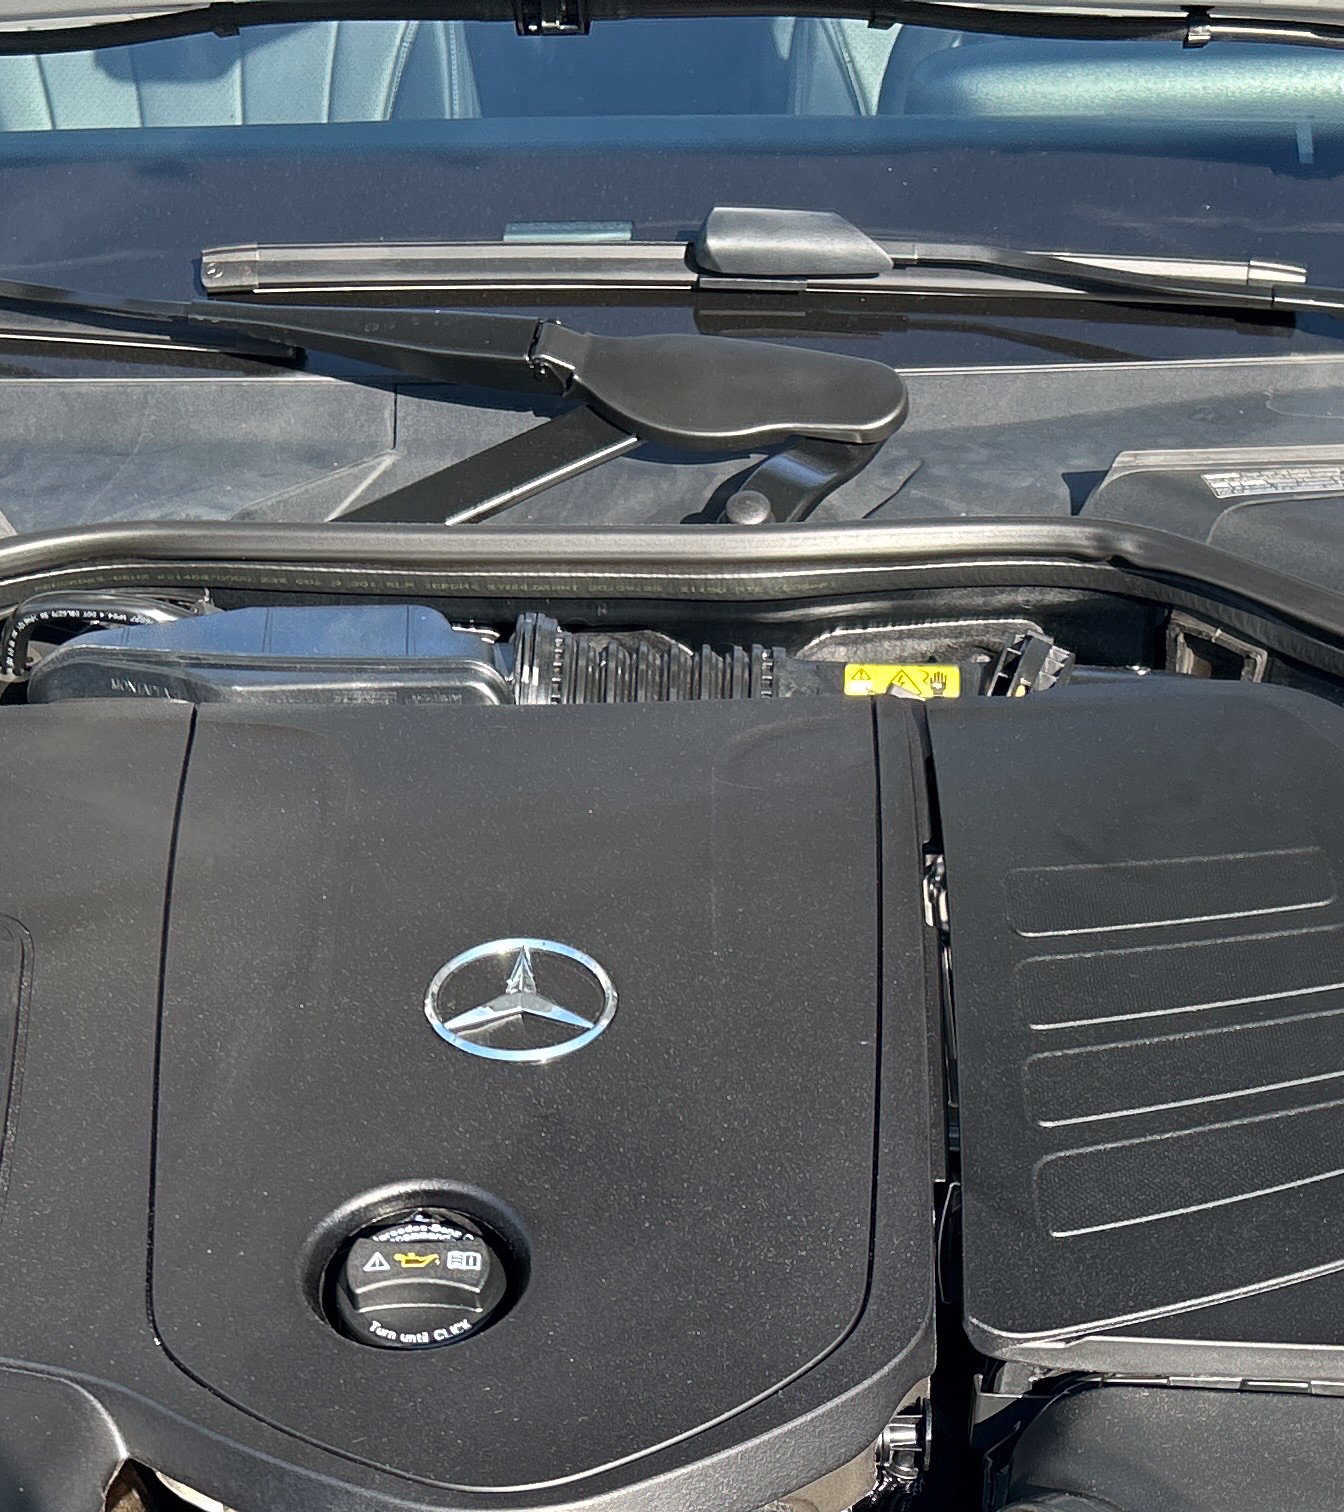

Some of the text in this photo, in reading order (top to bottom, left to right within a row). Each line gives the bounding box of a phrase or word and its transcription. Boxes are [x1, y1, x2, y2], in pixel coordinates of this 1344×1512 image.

[369, 1318, 473, 1343] Turn until CLICK
